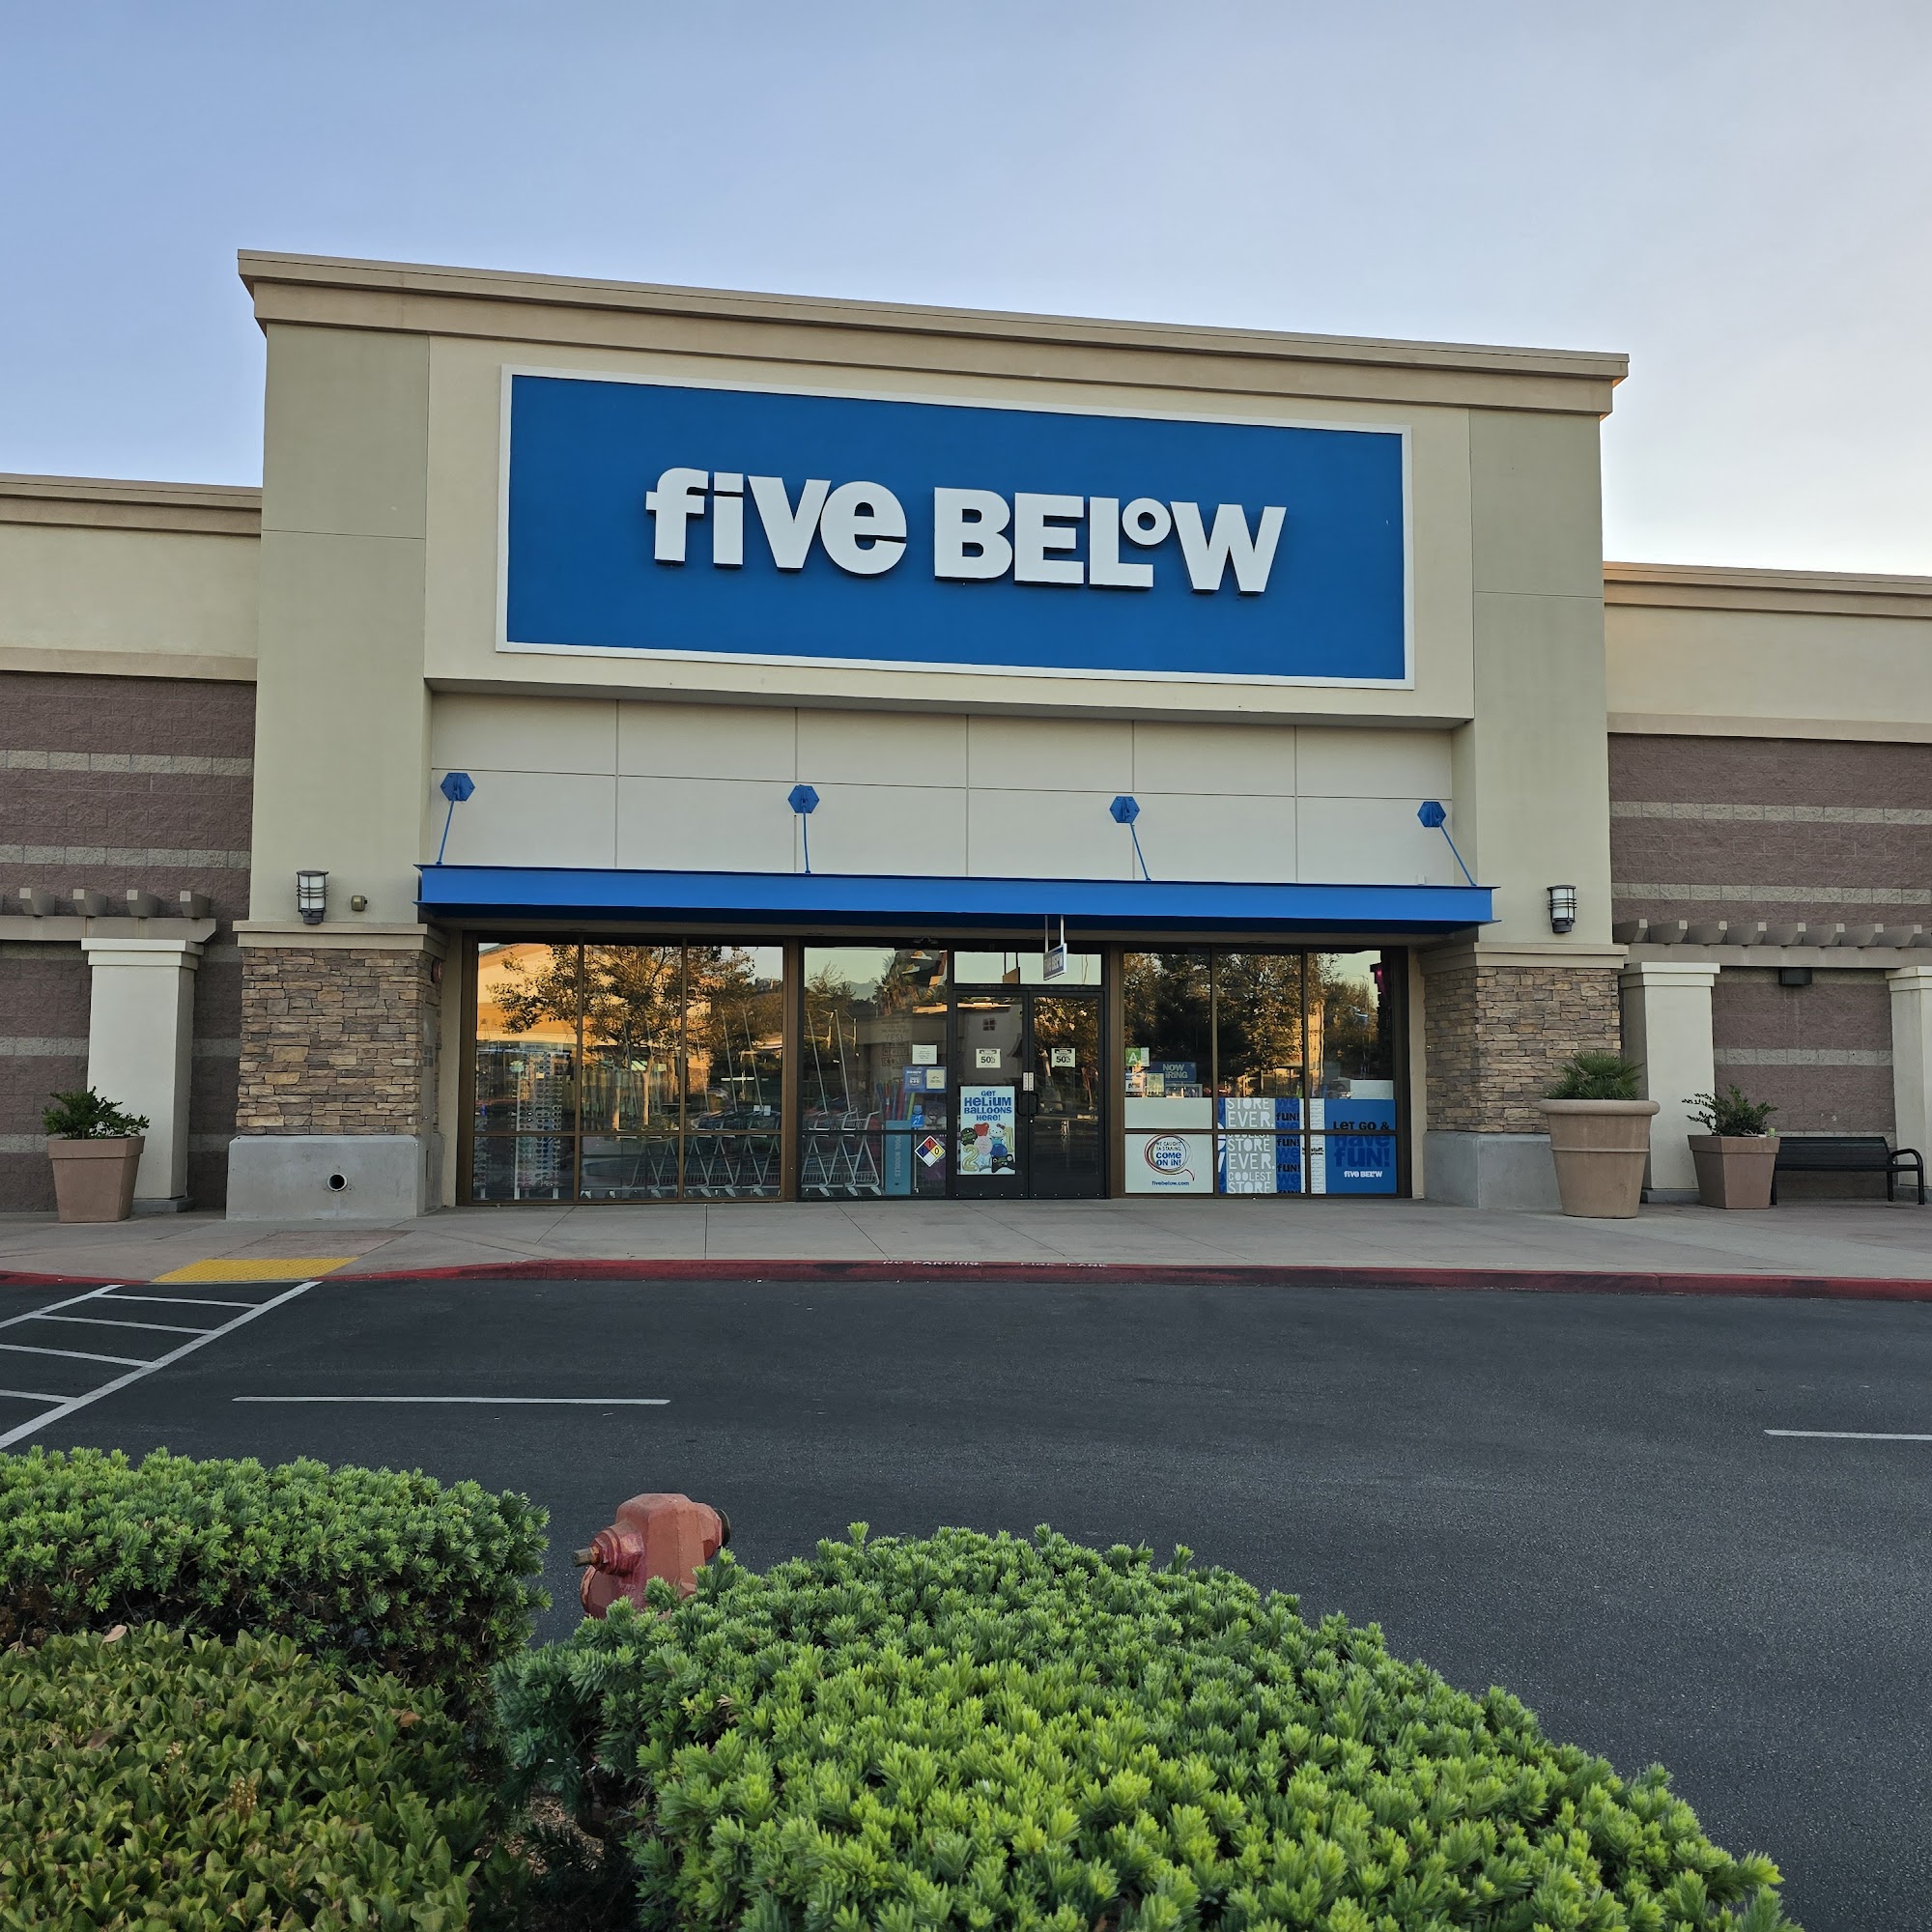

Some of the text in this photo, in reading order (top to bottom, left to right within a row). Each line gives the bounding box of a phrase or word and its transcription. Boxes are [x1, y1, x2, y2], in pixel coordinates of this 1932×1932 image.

[645, 467, 1288, 593] five BELOW
[1128, 1052, 1138, 1064] A
[1226, 1098, 1270, 1110] STORE
[1228, 1111, 1274, 1128] EVER.
[1358, 1122, 1377, 1130] GO
[1379, 1122, 1390, 1130] &
[927, 1140, 932, 1149] 1
[1227, 1138, 1271, 1152] STORE
[934, 1147, 940, 1155] 0
[1229, 1152, 1275, 1170] EVER.
[1228, 1171, 1272, 1181] COOLEST
